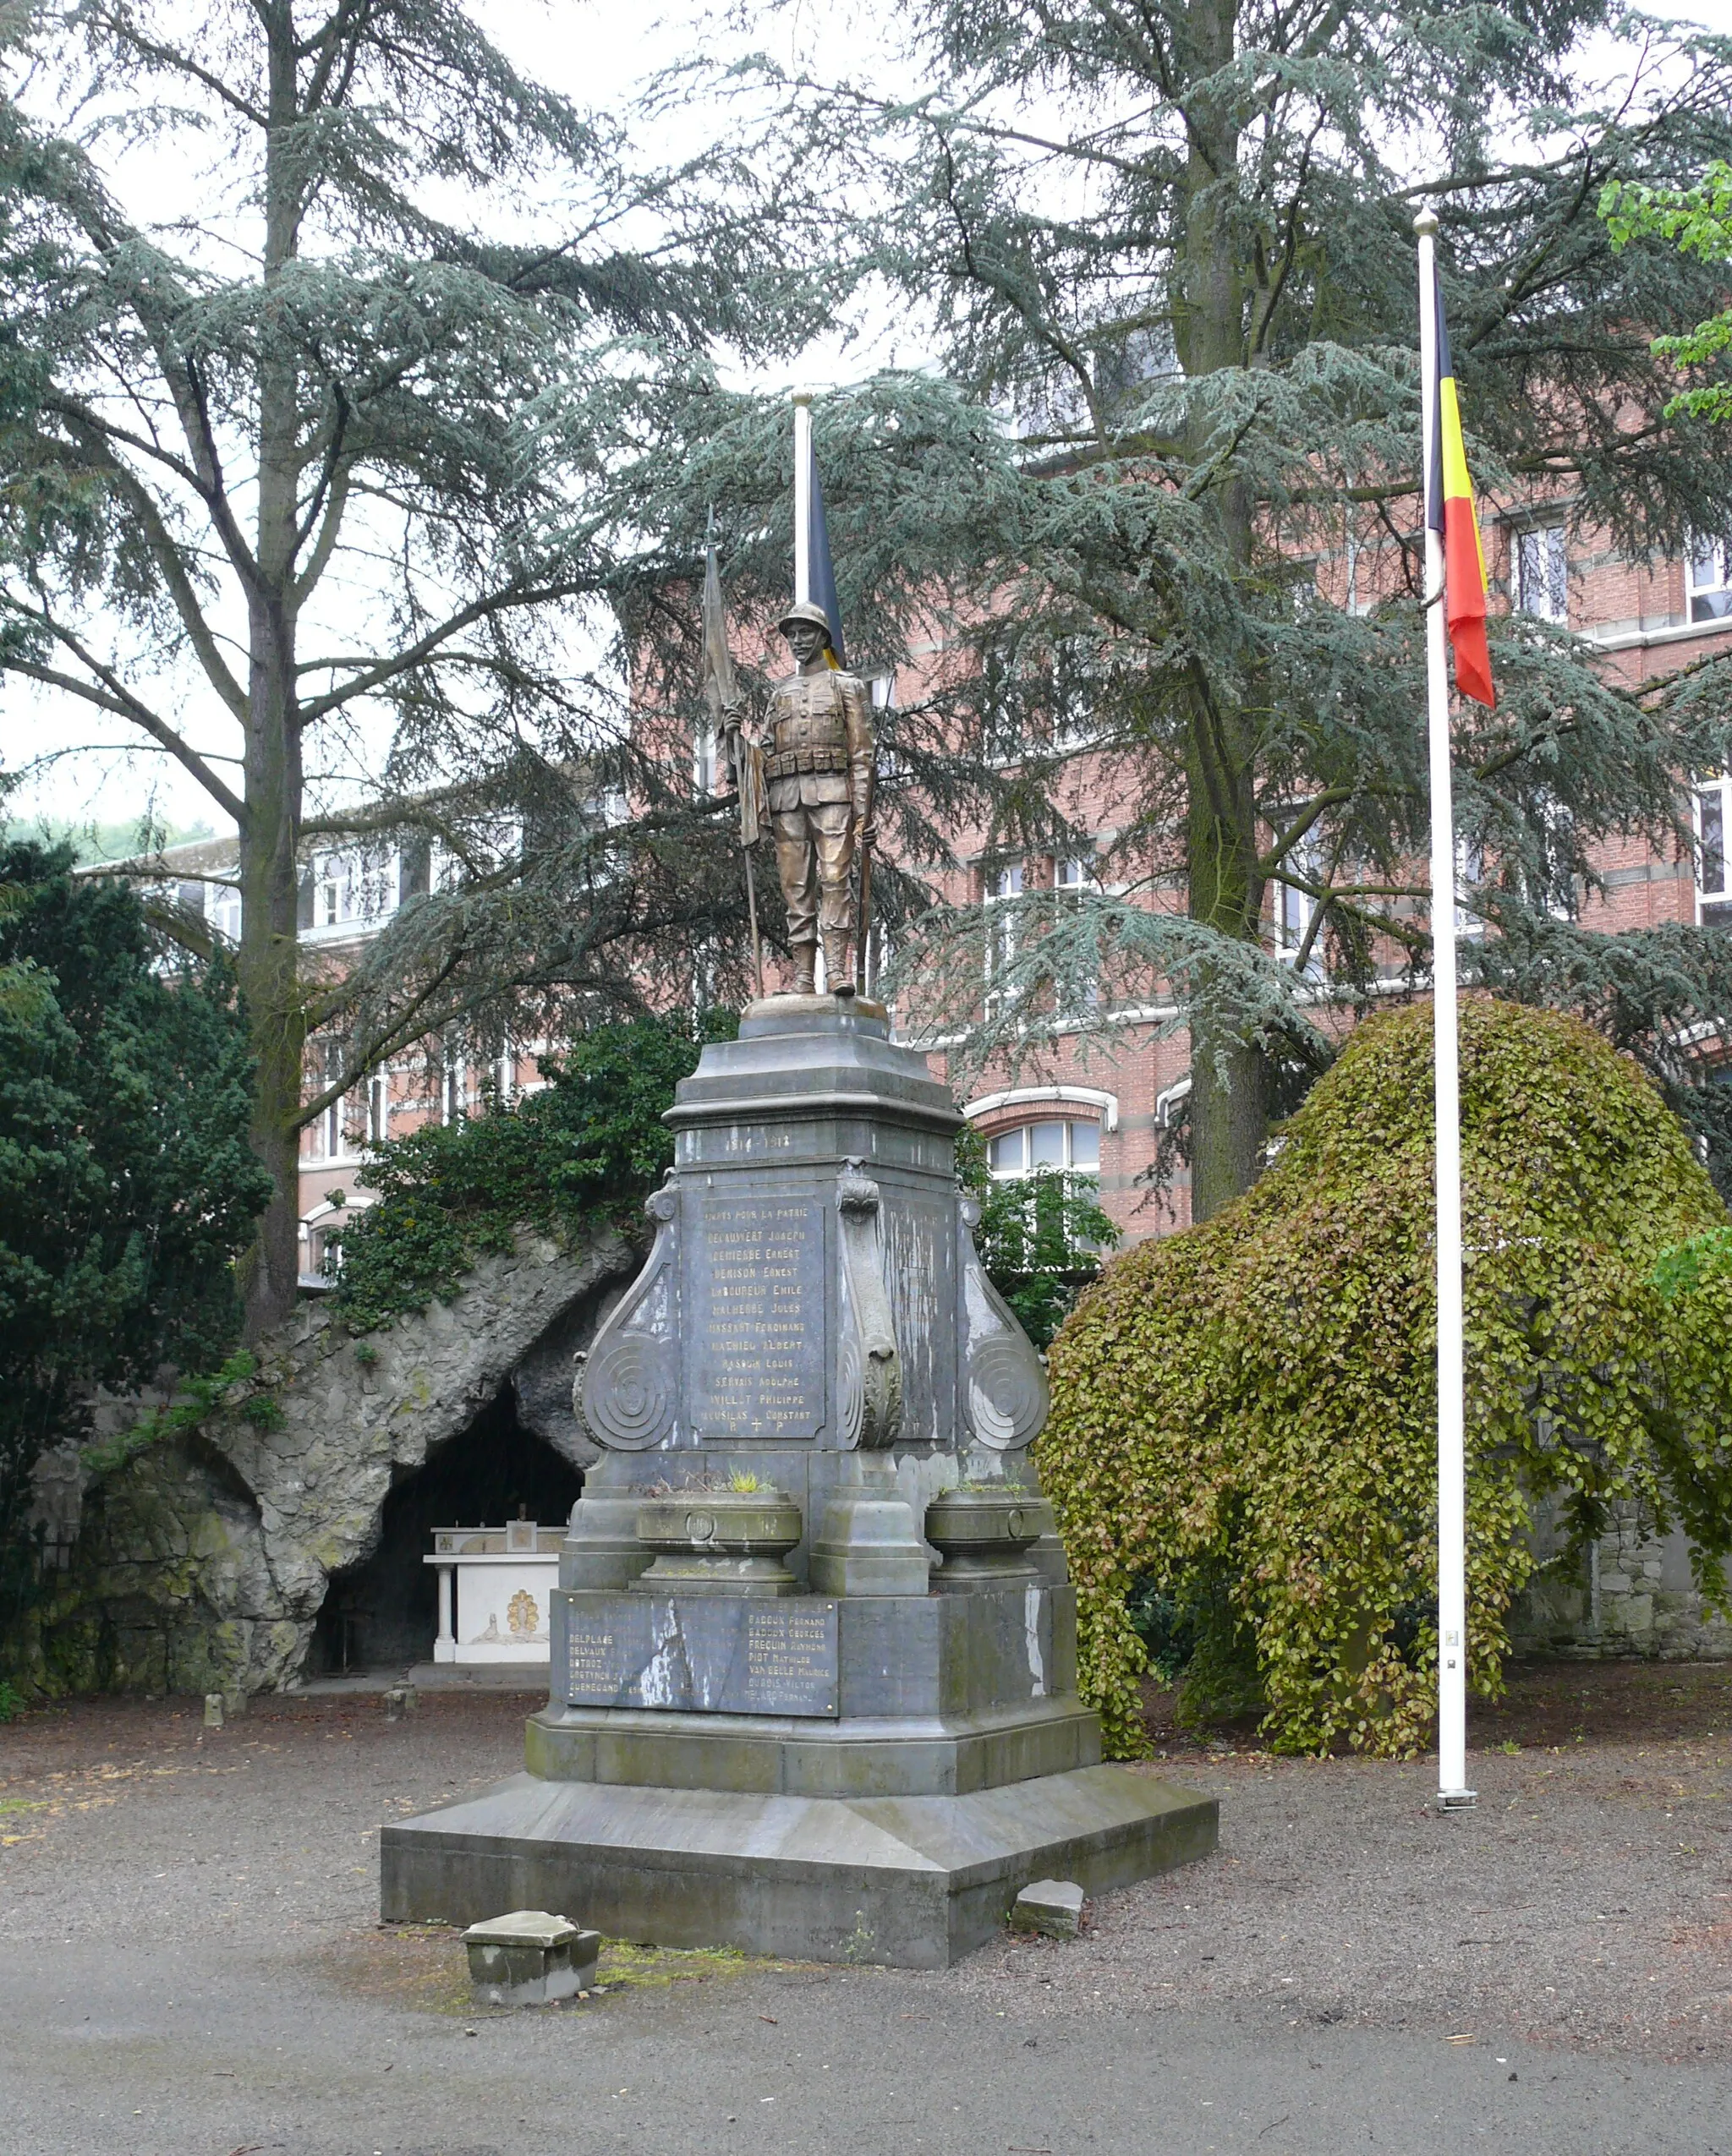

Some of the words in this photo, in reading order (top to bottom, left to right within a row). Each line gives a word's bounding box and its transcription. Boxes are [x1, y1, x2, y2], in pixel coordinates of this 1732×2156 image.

[735, 1210, 757, 1220] POUR
[761, 1210, 773, 1218] LA
[777, 1208, 809, 1219] PATRIE
[768, 1231, 805, 1241] JOSEPH
[765, 1248, 800, 1260] ERNEST
[763, 1267, 797, 1278] ERNEST
[773, 1285, 803, 1295] EMILE
[770, 1303, 801, 1314] JULES
[754, 1322, 805, 1332] FERDINAND
[763, 1340, 803, 1351] ALBERT
[765, 1359, 793, 1369] LOUIS
[715, 1376, 753, 1387] SERVAIS
[759, 1377, 799, 1387] ADOLPHE
[710, 1394, 752, 1404] WILLT
[759, 1393, 804, 1404] PHILIPPE
[788, 1616, 825, 1627] FERNAND
[788, 1628, 825, 1639] GEORGES
[569, 1646, 606, 1656] DELVAUX
[791, 1641, 826, 1651] RAYMOND
[772, 1654, 811, 1664] MATHILDE
[749, 1666, 765, 1676] VAN
[748, 1677, 781, 1688] DUBOIS
